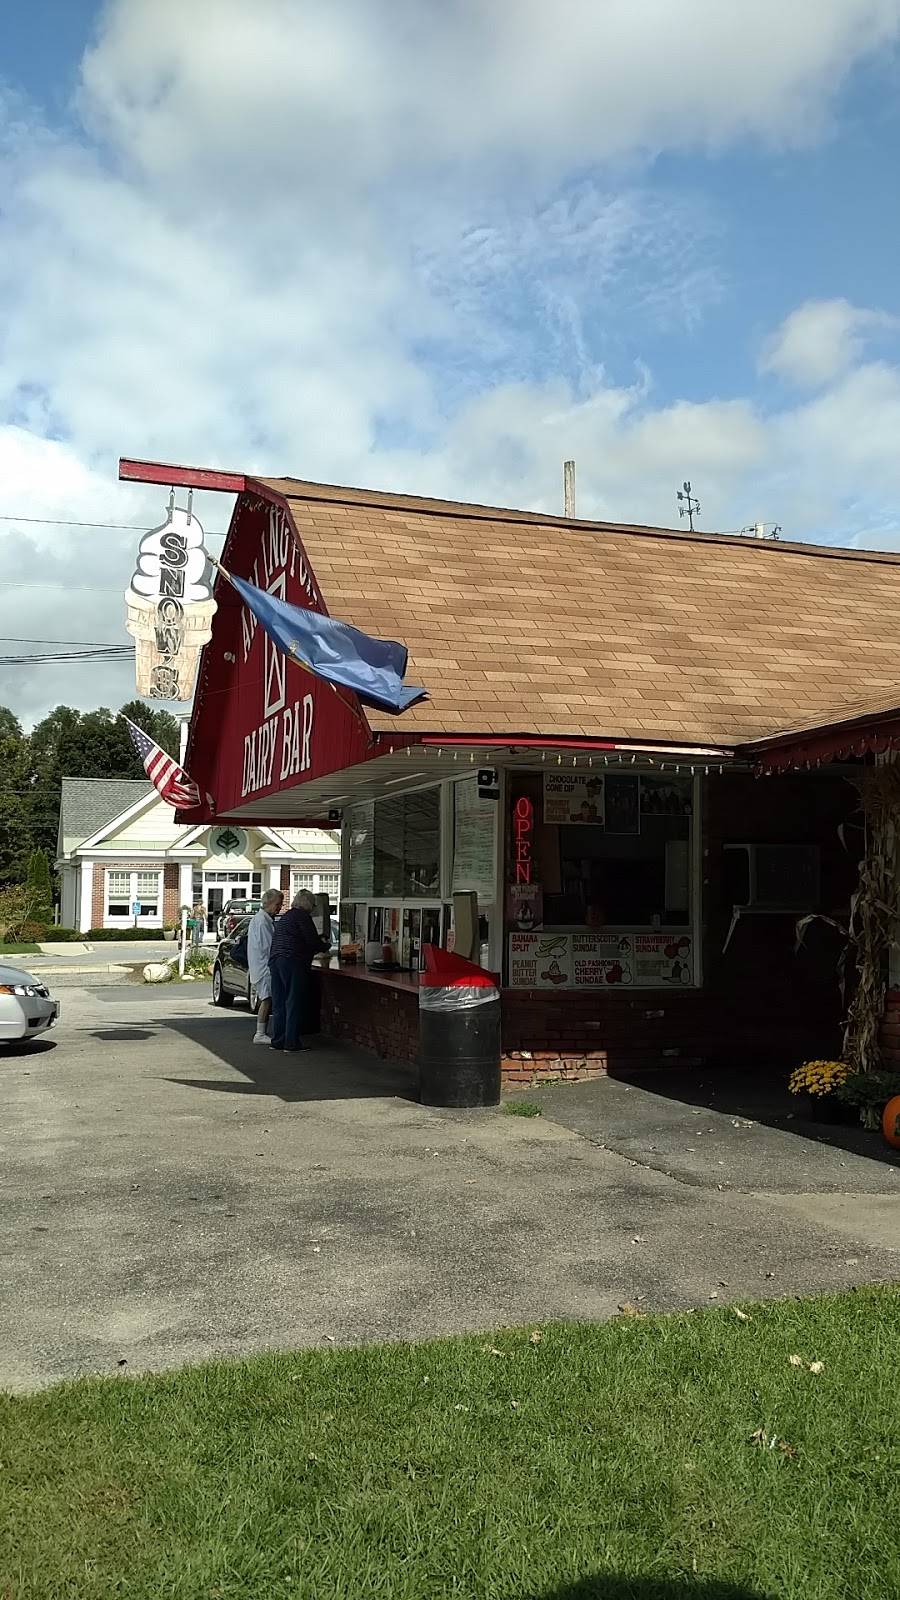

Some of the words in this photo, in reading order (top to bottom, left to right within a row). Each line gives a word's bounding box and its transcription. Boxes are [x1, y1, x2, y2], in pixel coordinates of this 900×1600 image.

[150, 532, 188, 700] SNOW'S
[241, 716, 279, 798] DAIRY
[280, 693, 314, 781] BAR
[549, 775, 586, 785] CHOCOLATE
[546, 783, 562, 792] CONE
[564, 784, 575, 793] DIP
[516, 797, 531, 884] OPEN
[512, 934, 538, 942] BANANA
[572, 935, 619, 943] BUTTERSCOTCH
[512, 943, 529, 952] SPLIT
[572, 944, 598, 952] SUNDAE
[512, 960, 538, 968] PEANUT
[512, 969, 537, 977] BUTTER
[574, 967, 603, 976] CHERRY
[574, 976, 603, 985] SUNDAE
